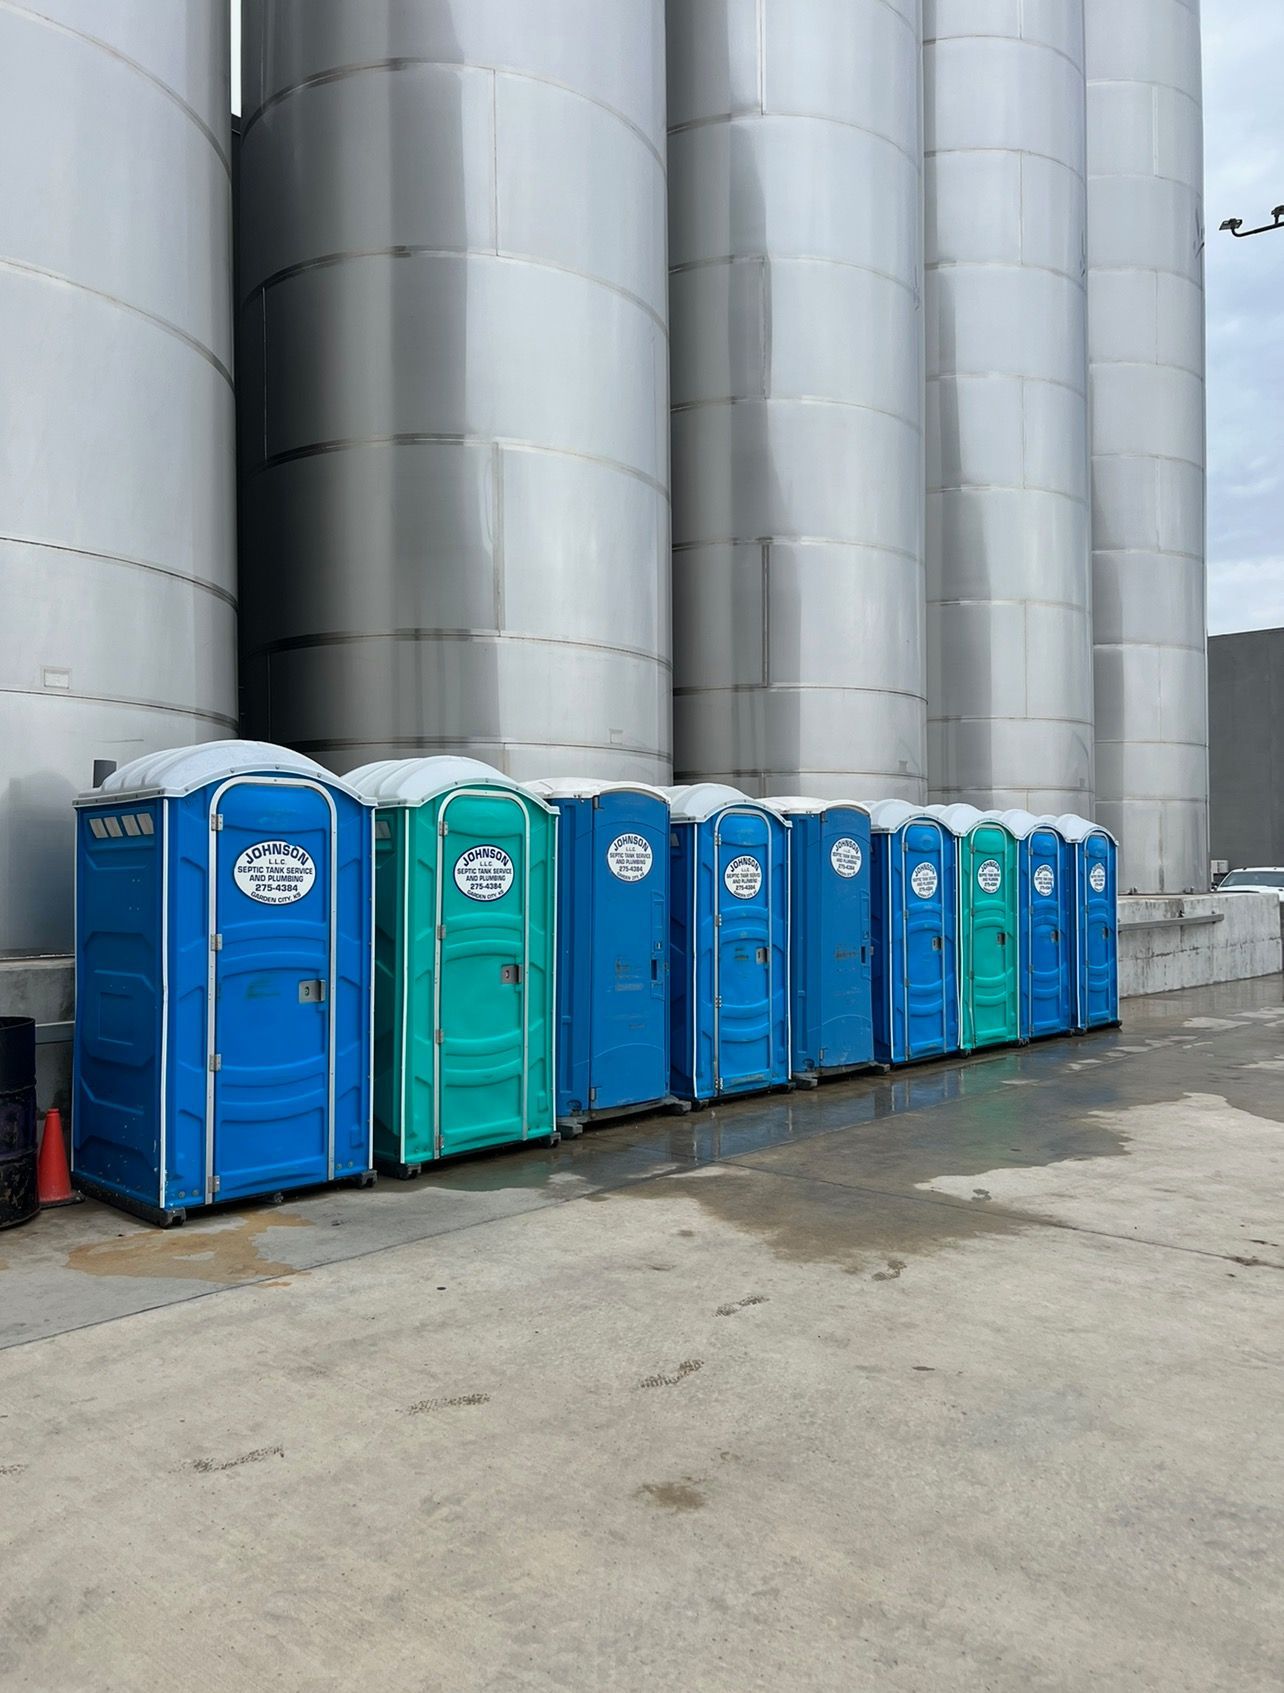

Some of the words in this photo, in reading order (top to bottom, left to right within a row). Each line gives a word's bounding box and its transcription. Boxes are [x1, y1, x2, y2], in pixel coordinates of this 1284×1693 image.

[614, 836, 648, 852] JOHNSON
[836, 840, 859, 854] JOHNSON
[245, 844, 309, 866] JOHNSON
[463, 848, 509, 866] JOHNSON
[730, 858, 758, 872] JOHNSON
[251, 891, 276, 902] GARDEN
